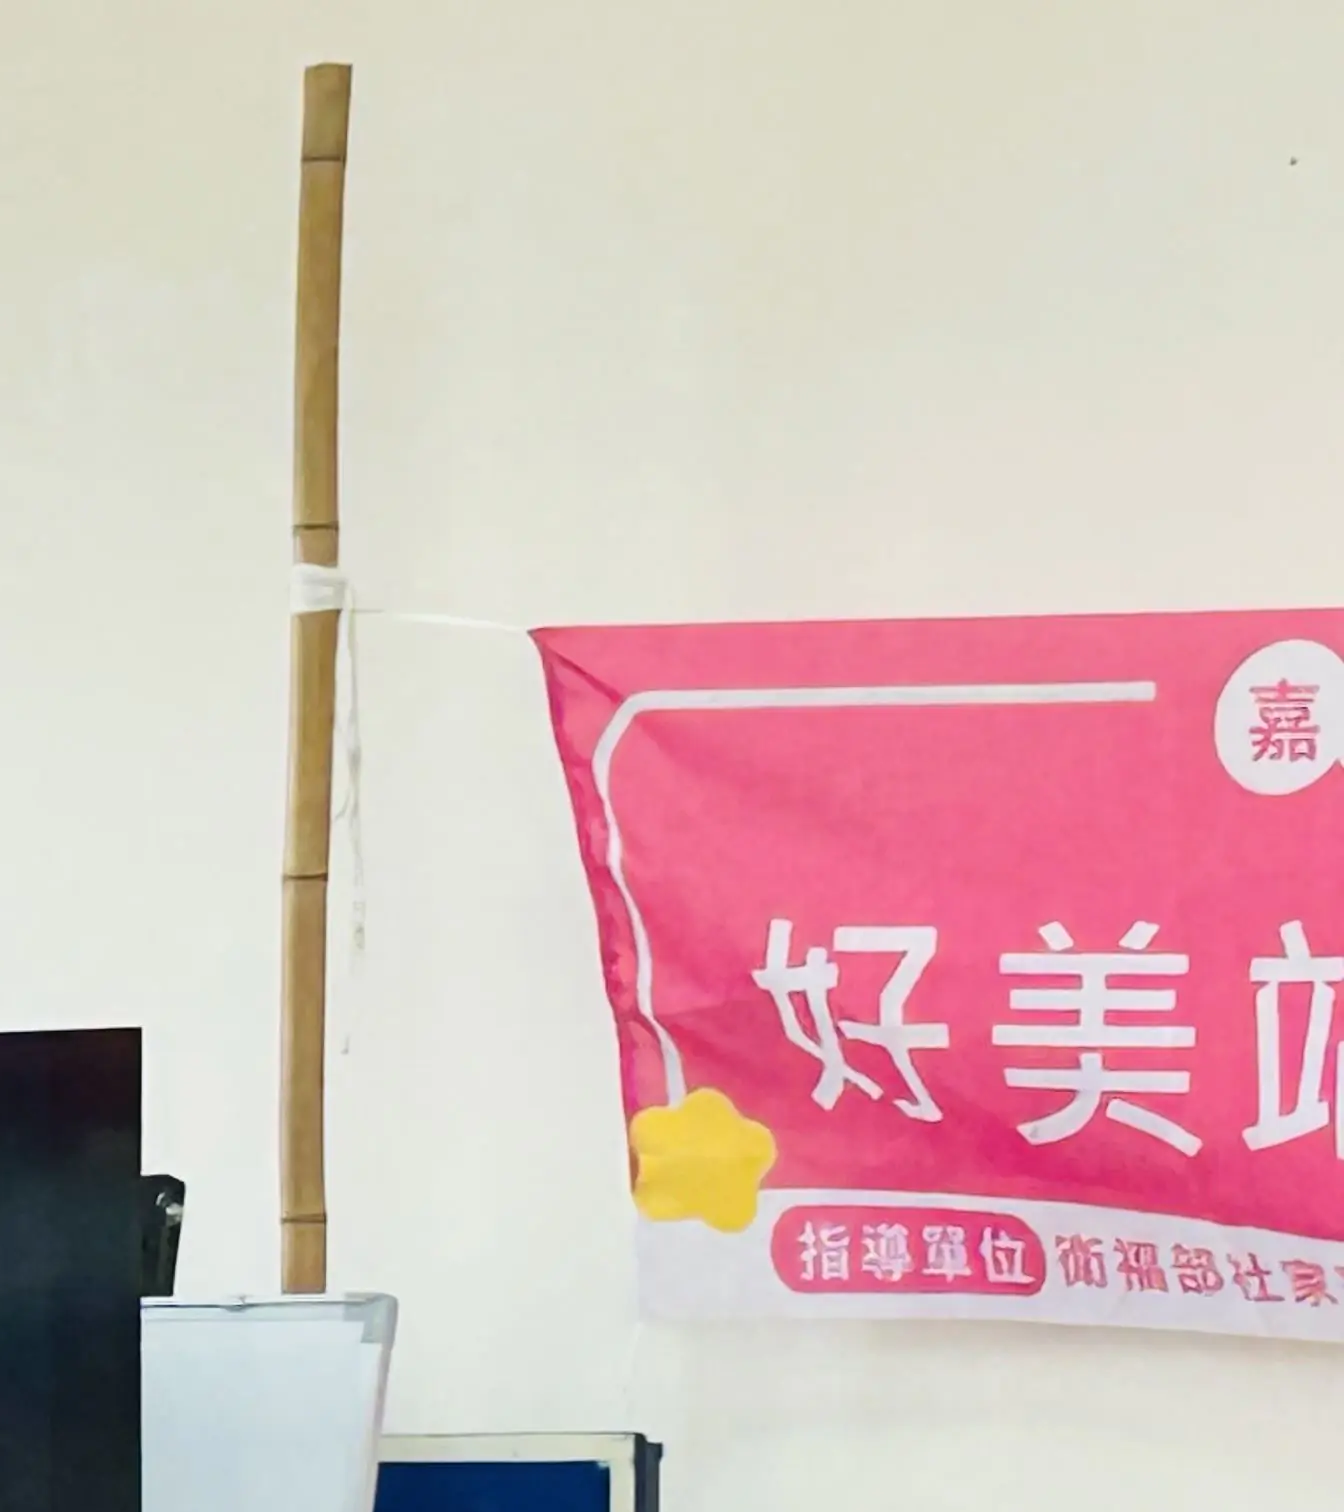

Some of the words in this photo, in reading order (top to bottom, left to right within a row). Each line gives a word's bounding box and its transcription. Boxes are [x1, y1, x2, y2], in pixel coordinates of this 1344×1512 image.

[1249, 678, 1321, 763] 嘉
[797, 1219, 1037, 1285] 指導單位
